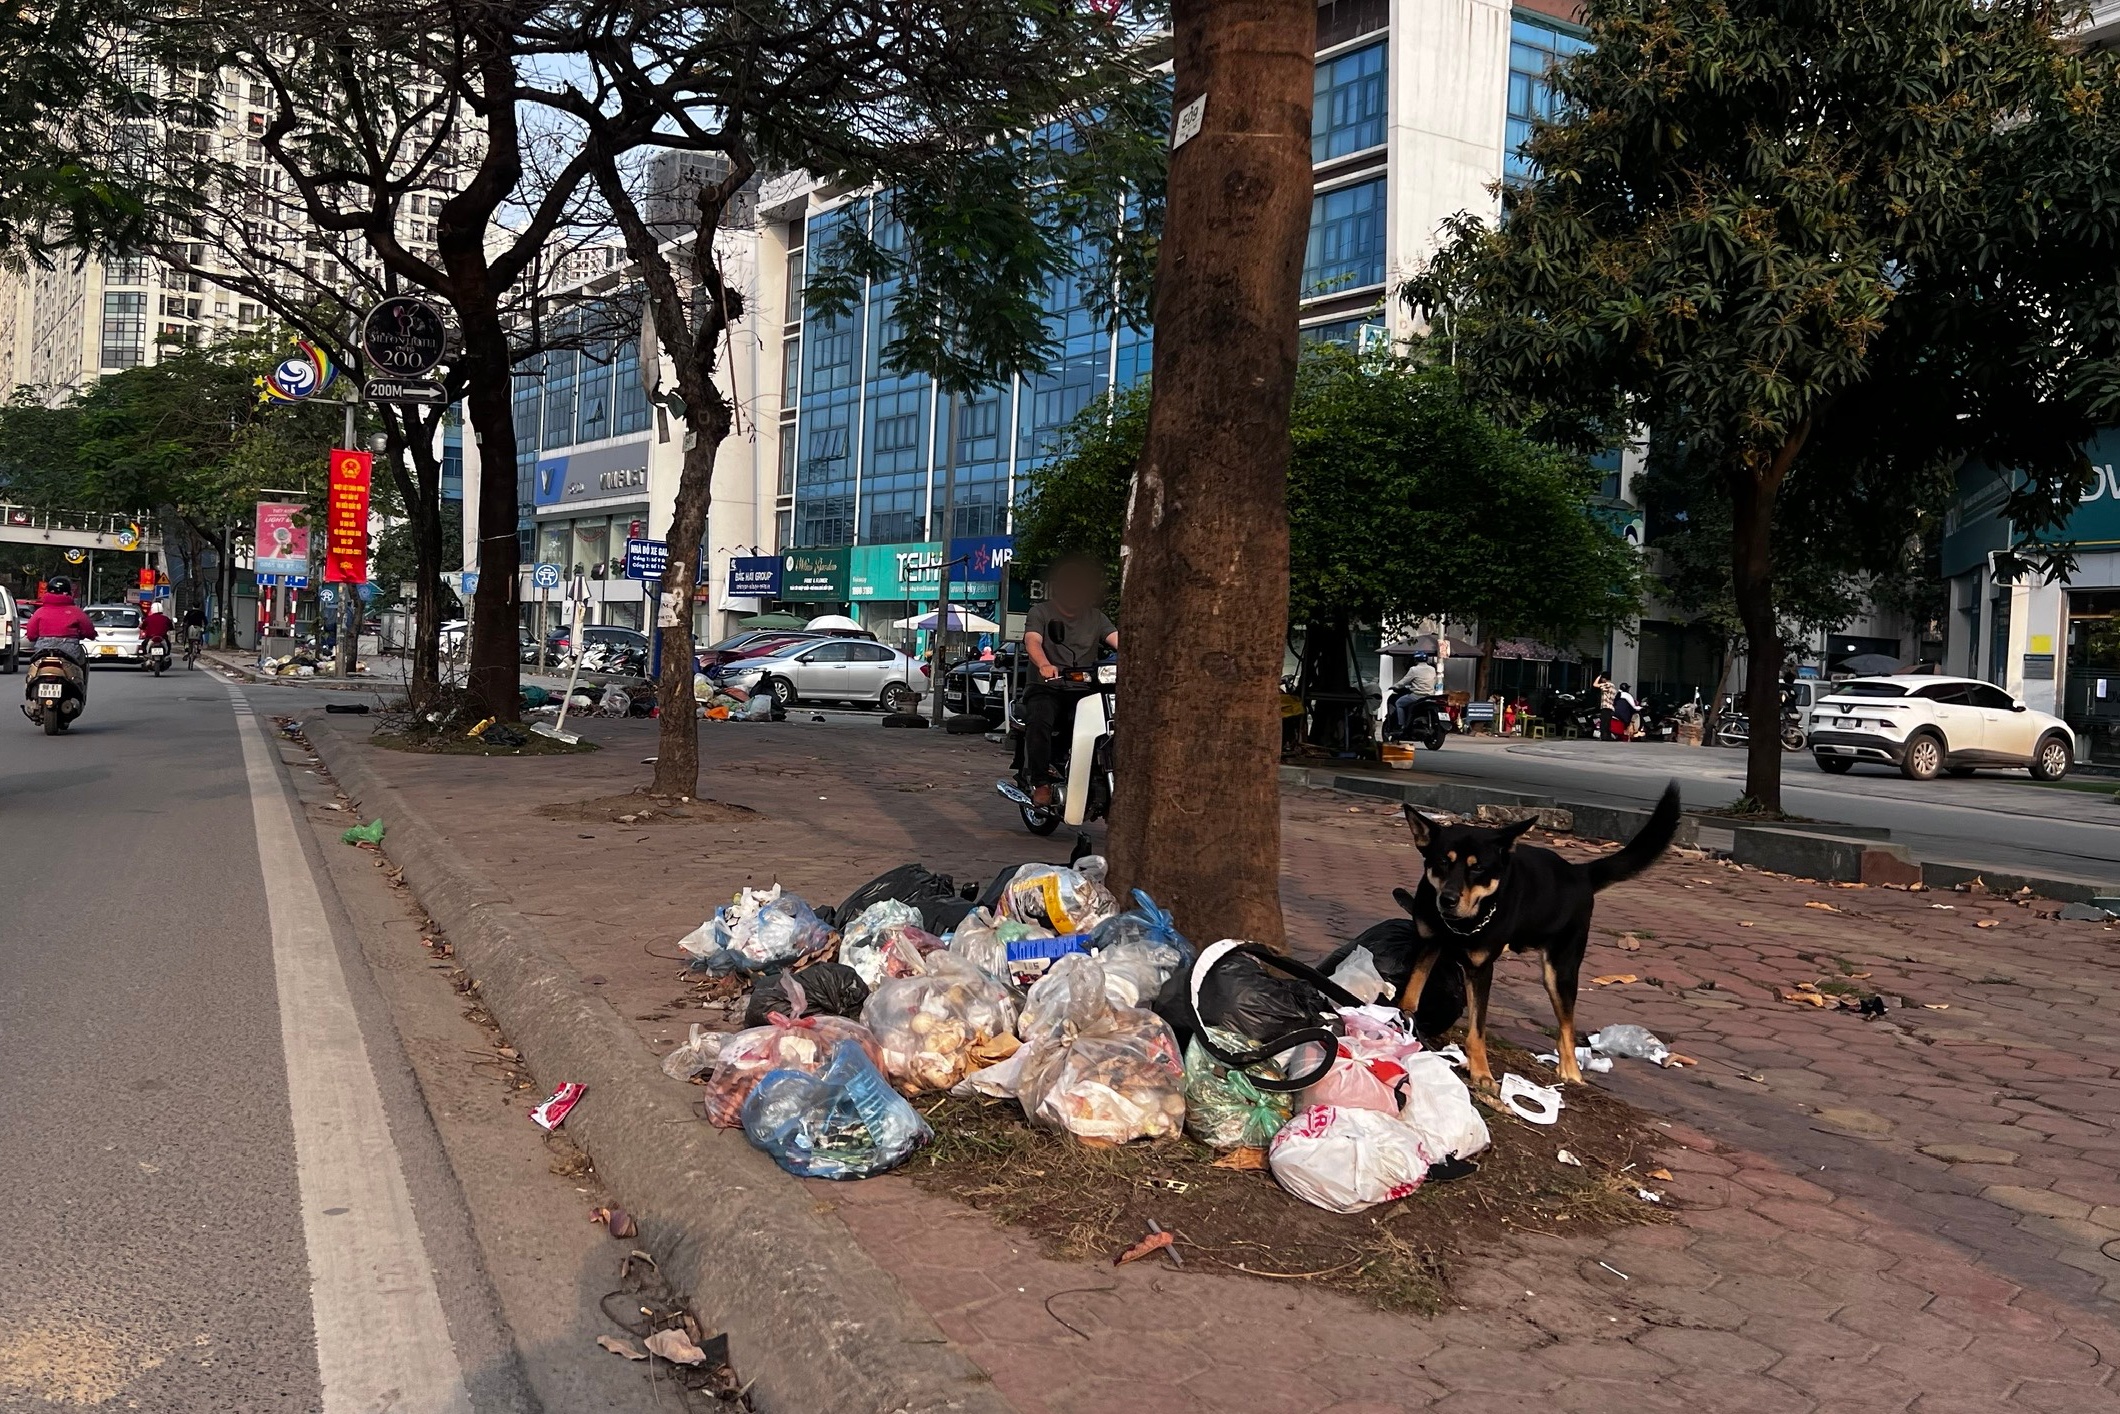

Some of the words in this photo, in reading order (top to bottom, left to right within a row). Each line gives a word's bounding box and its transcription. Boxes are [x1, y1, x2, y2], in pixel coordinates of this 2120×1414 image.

[1182, 105, 1199, 129] 509
[371, 384, 402, 397] 200M
[651, 546, 658, 556] XE
